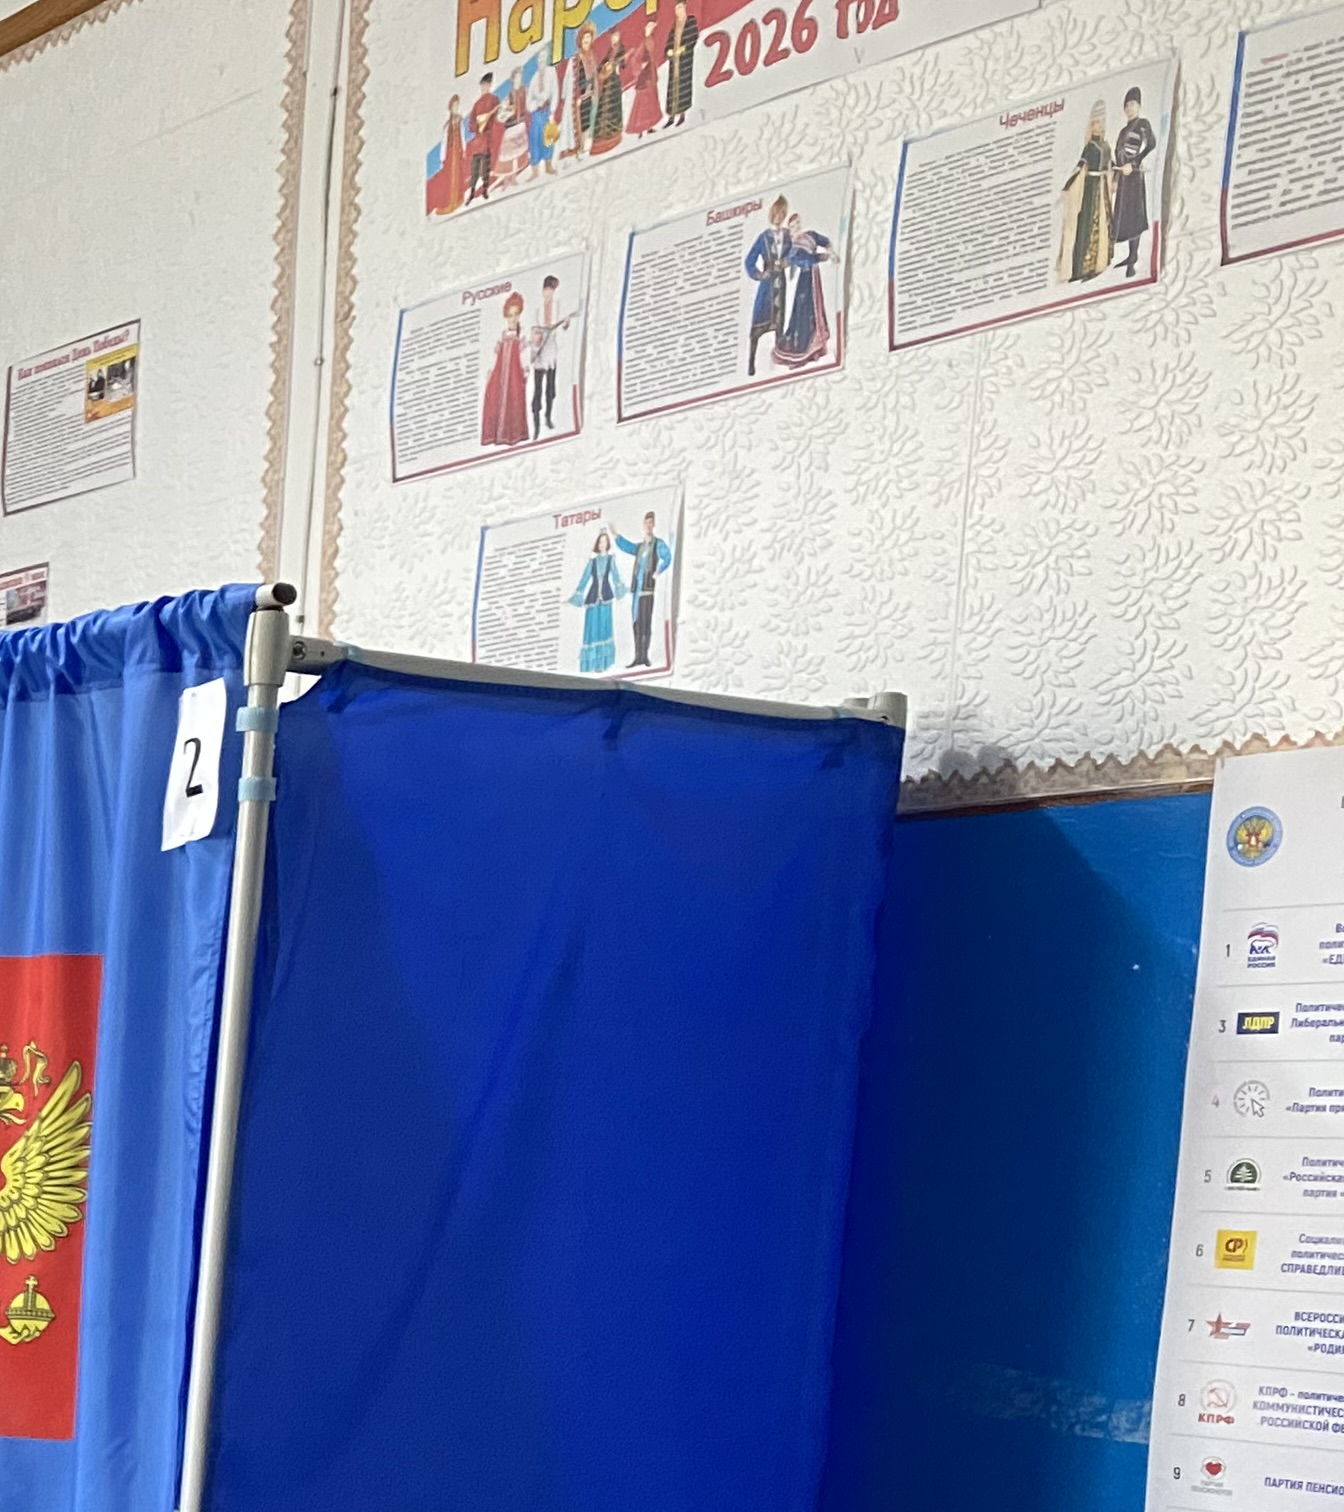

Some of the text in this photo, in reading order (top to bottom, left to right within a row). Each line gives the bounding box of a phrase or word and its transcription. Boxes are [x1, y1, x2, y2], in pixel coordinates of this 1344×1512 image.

[455, 0, 657, 77] Нар
[704, 0, 818, 88] 2026
[999, 98, 1065, 130] Чеченцы
[706, 199, 763, 226] Башкиры
[461, 281, 512, 305] Русские
[553, 508, 602, 529] Татары
[183, 737, 204, 798] 2
[1226, 943, 1231, 957] 1
[1218, 1020, 1226, 1033] 3
[1242, 1016, 1276, 1031] ЛДПР
[1204, 1169, 1212, 1183] 5
[1195, 1243, 1204, 1257] 6
[1188, 1318, 1196, 1332] 7
[1258, 1385, 1288, 1398] КПРФ
[1177, 1393, 1186, 1407] 8
[1197, 1412, 1235, 1425] КПРФ
[1260, 1415, 1329, 1432] РОССИЙСКОЙ
[1173, 1466, 1181, 1480] 9
[1264, 1476, 1304, 1491] ПАРТИЯ
